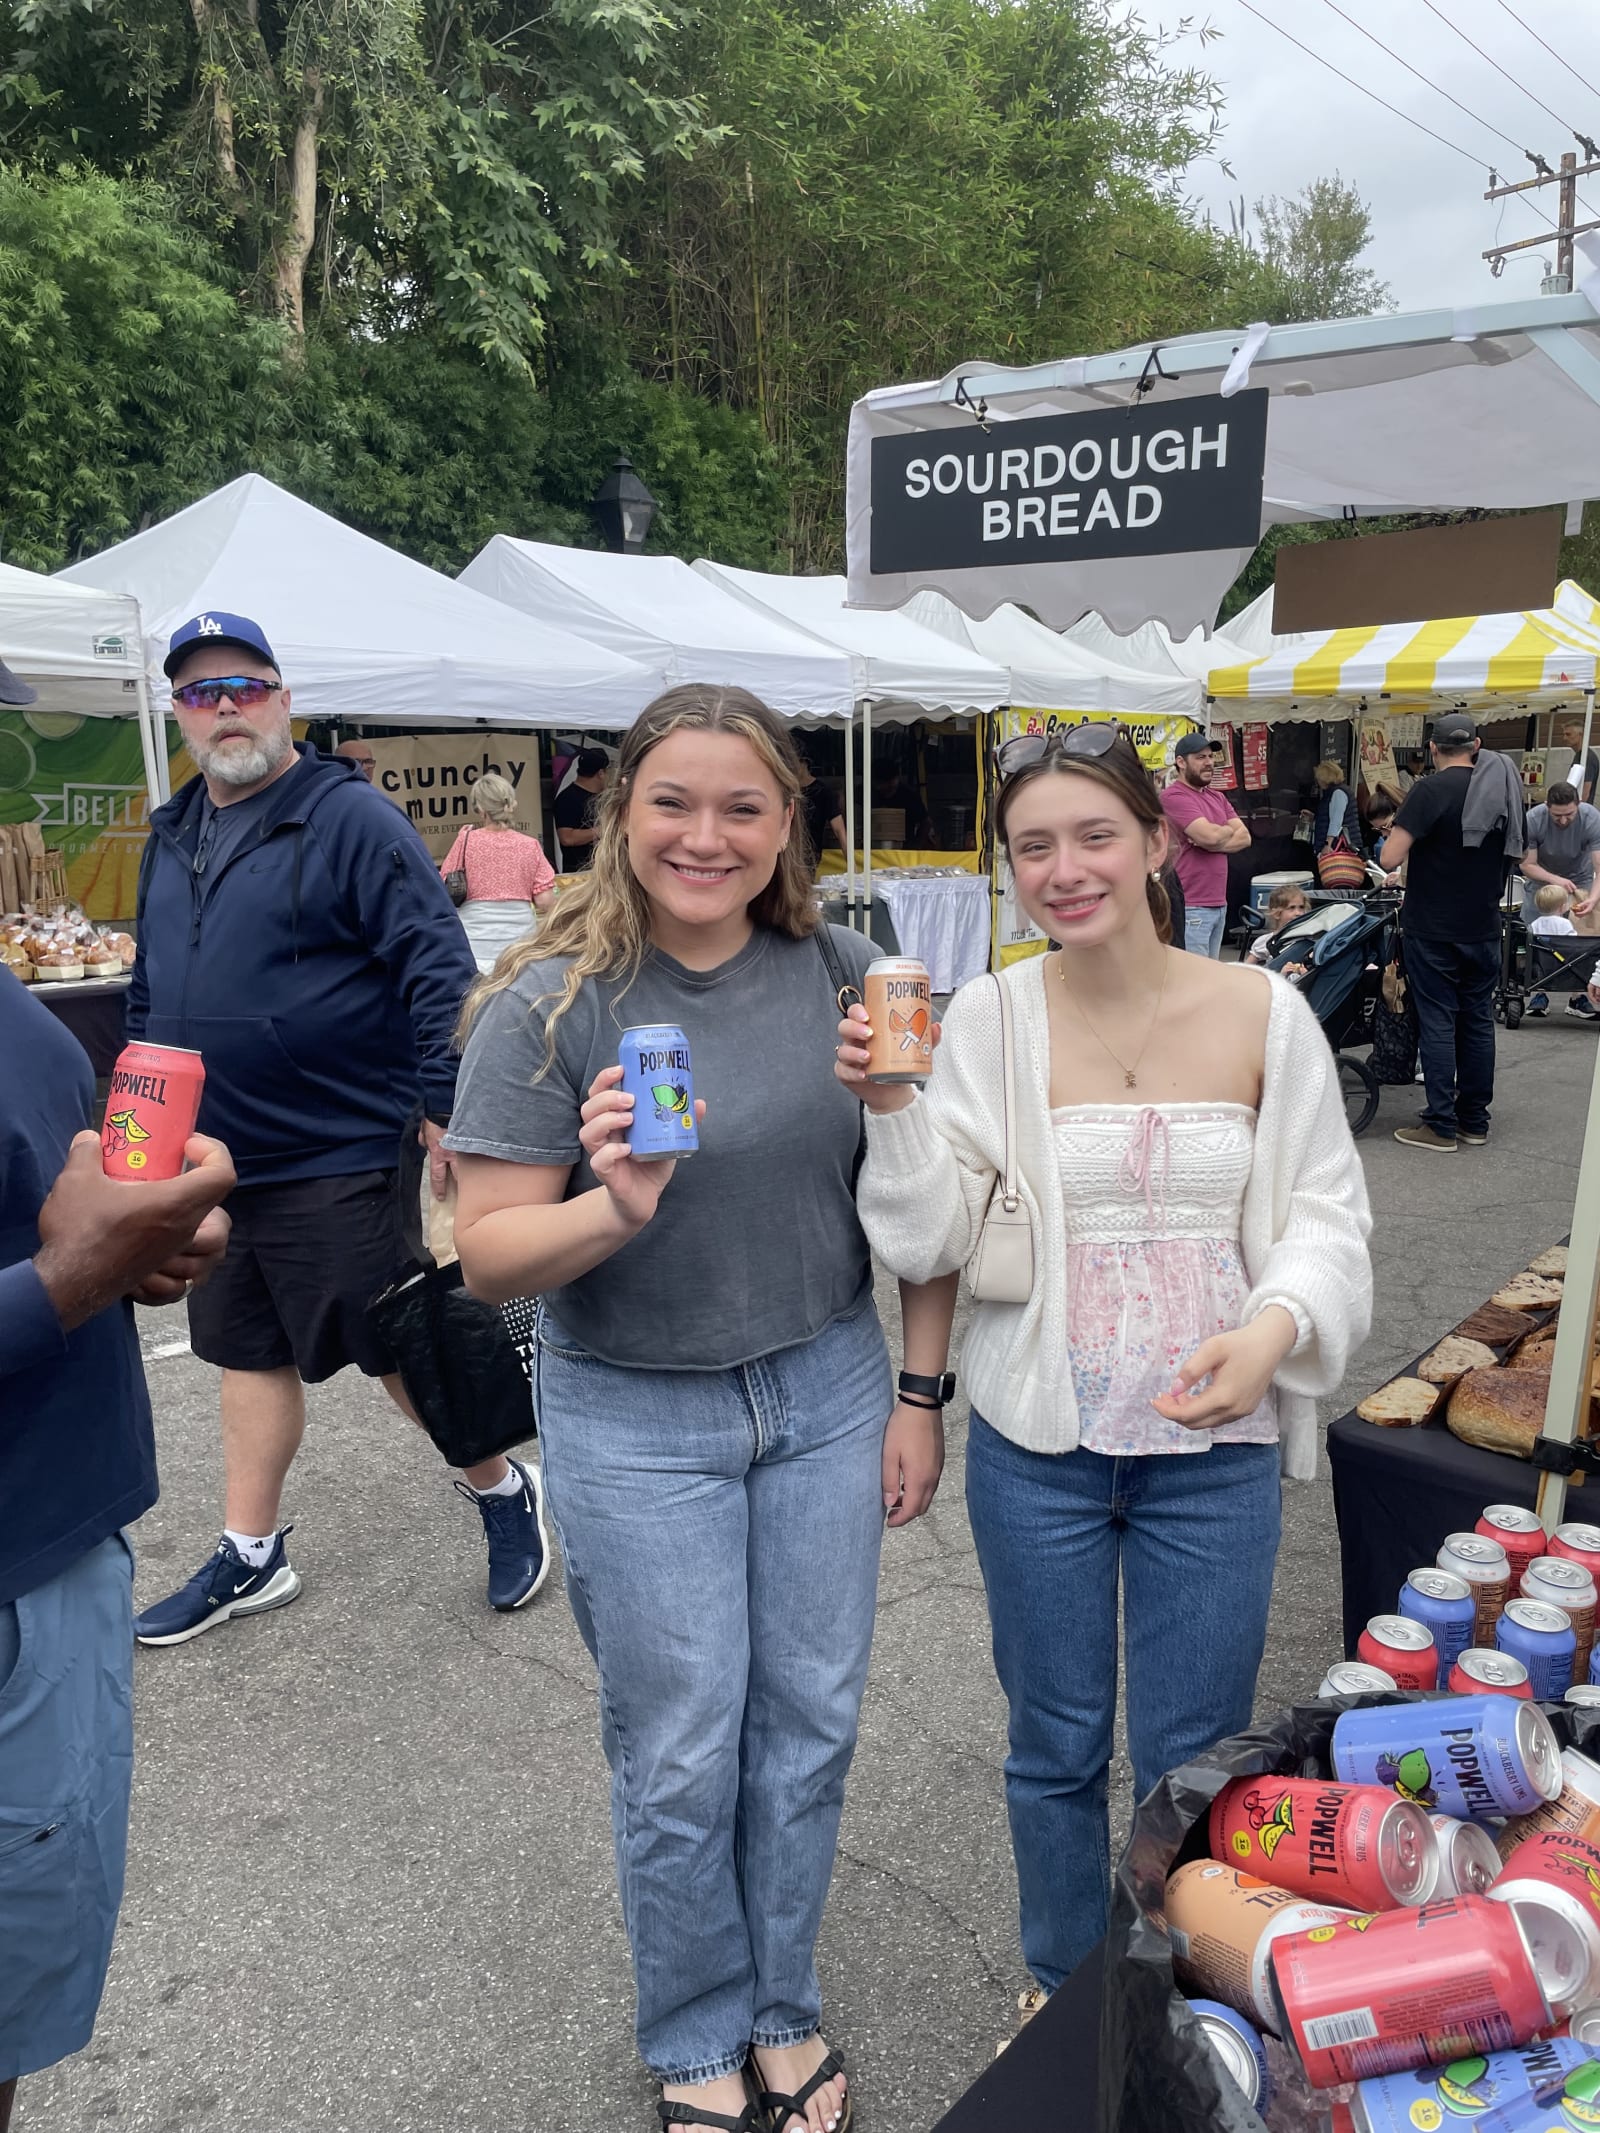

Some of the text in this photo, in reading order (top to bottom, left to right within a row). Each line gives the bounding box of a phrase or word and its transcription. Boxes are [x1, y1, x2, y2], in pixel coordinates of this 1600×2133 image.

[905, 423, 1228, 499] SOURDOUGH
[982, 485, 1163, 542] BREAD
[197, 615, 223, 635] LA
[886, 981, 930, 1003] POPWELL
[639, 1049, 691, 1076] POPWELL
[1440, 1727, 1500, 1815] POPWELL
[1495, 1737, 1528, 1800] BLACKBERRY LIME
[1308, 1786, 1352, 1876] POPWELL
[1563, 1816, 1576, 1829] 35
